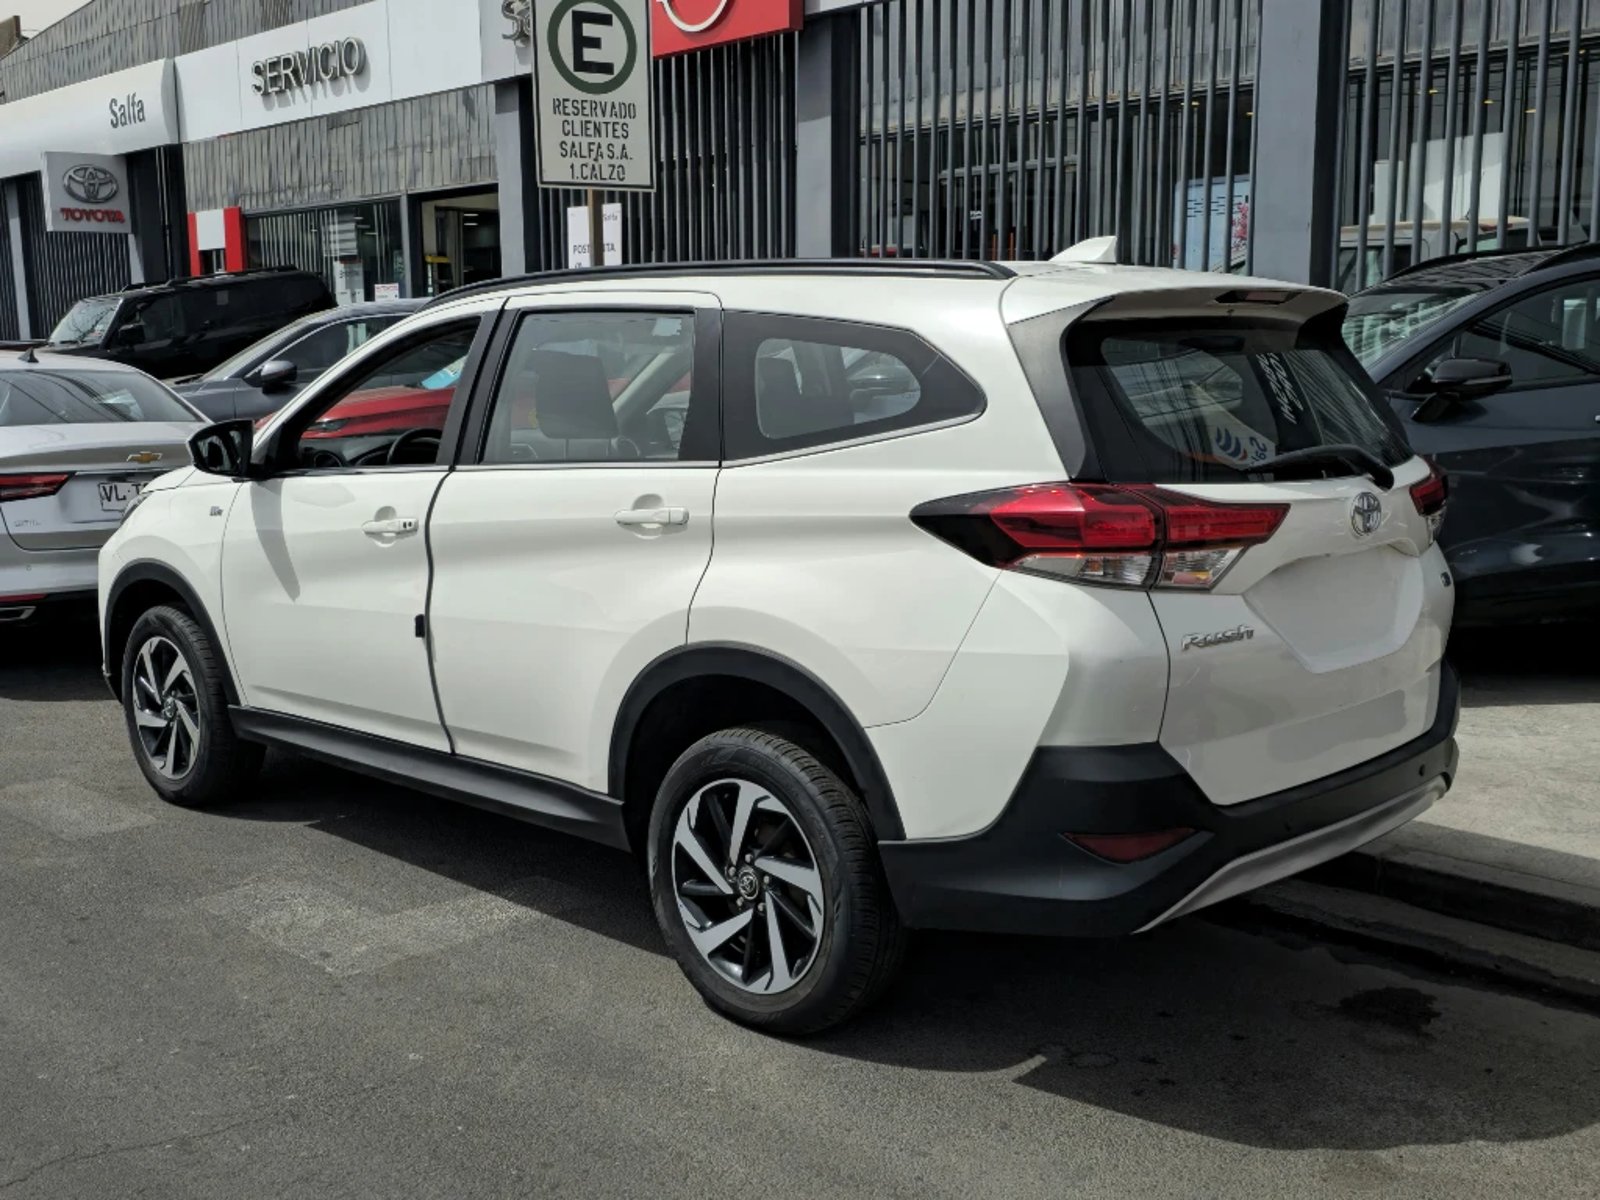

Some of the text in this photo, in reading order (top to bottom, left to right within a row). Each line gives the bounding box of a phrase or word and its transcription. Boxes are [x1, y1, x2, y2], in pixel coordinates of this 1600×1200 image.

[571, 10, 614, 75] E
[252, 37, 367, 95] SERVICIO
[109, 92, 146, 129] Salfa
[553, 98, 637, 119] RESERVADO
[562, 120, 629, 139] CLIENTES
[560, 140, 634, 161] SALFA S.A.
[570, 163, 626, 181] 1.CALZO
[60, 207, 126, 224] TOYOTA
[1182, 624, 1255, 651] Rush
